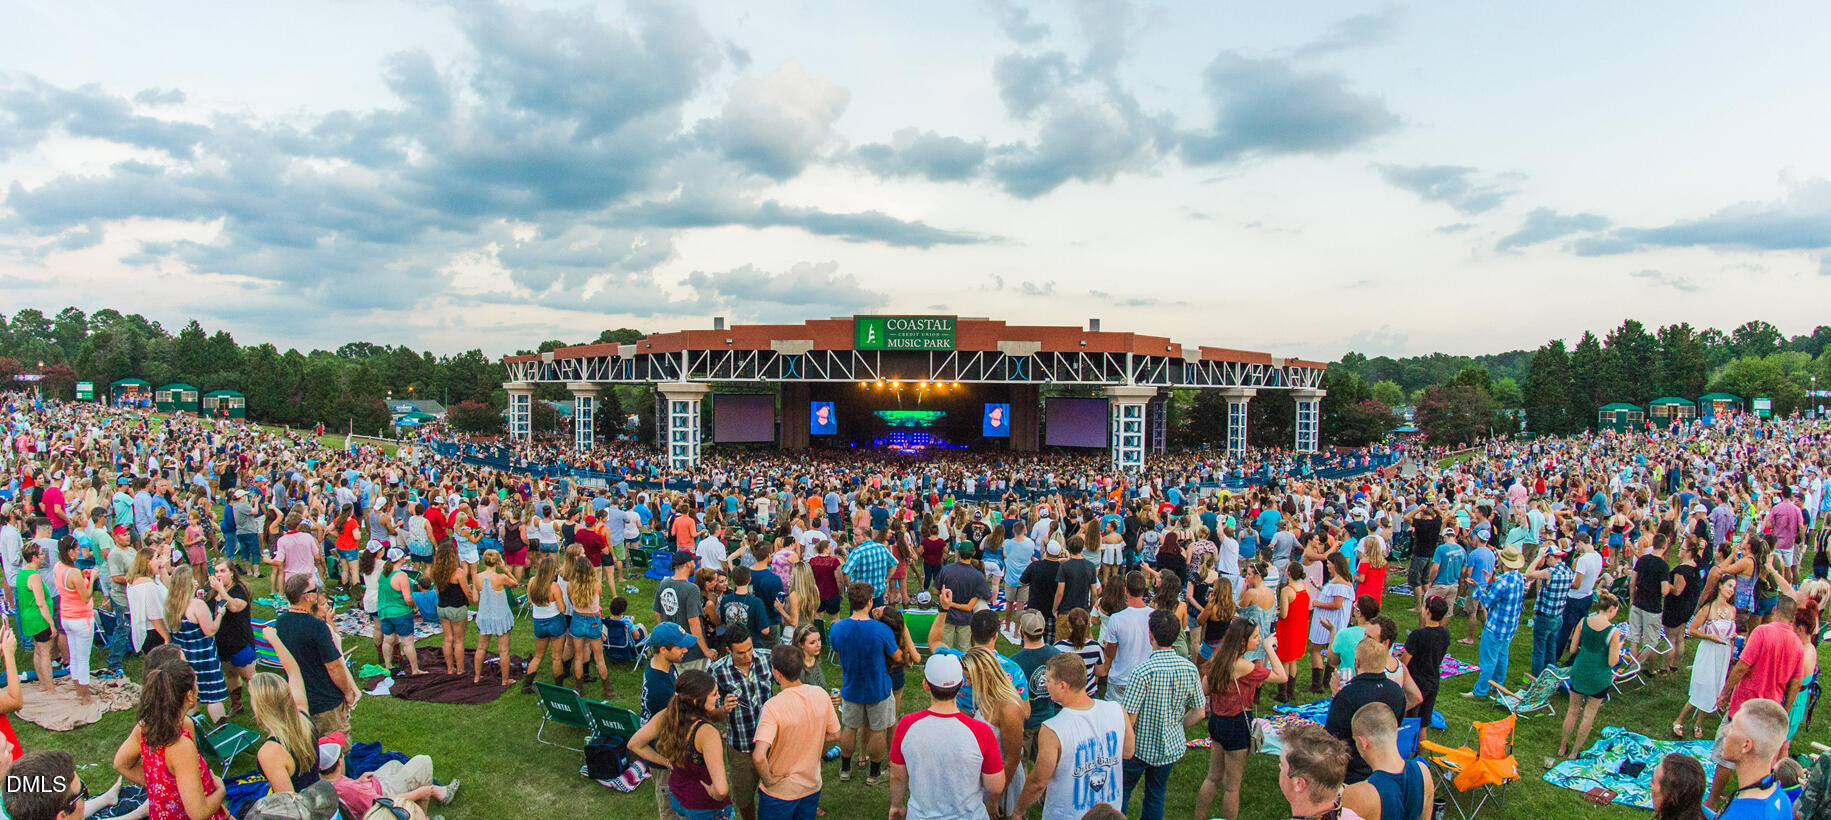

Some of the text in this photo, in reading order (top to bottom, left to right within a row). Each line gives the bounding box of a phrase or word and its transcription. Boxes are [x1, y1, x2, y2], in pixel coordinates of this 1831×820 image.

[887, 319, 951, 331] COASTAL
[887, 339, 951, 348] MUSIC PARK
[550, 701, 572, 713] RENTAL
[601, 719, 625, 731] RENTAL
